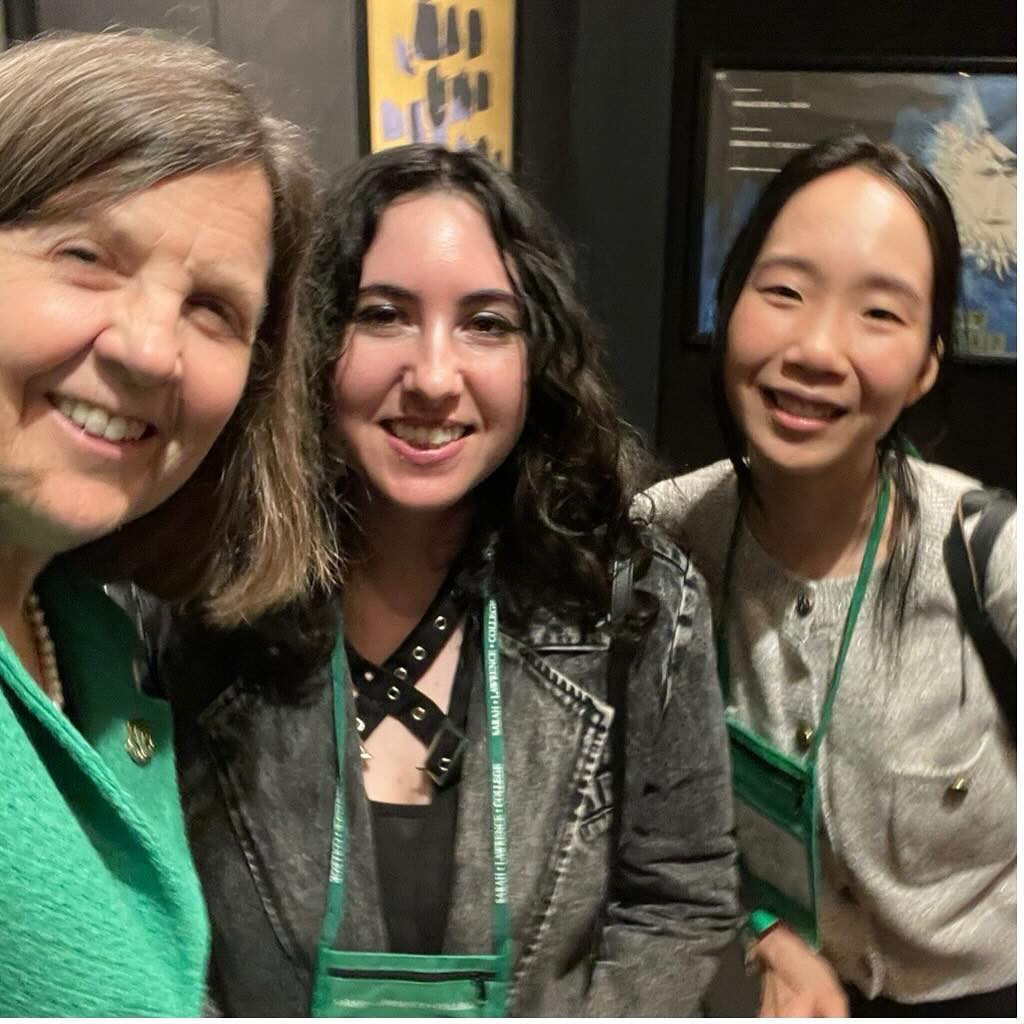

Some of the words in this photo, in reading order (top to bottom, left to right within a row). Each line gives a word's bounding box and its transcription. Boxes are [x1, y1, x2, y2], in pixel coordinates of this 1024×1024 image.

[488, 648, 500, 700] LAWRENCE
[491, 705, 502, 736] SARAH
[494, 872, 507, 904] SARAH
